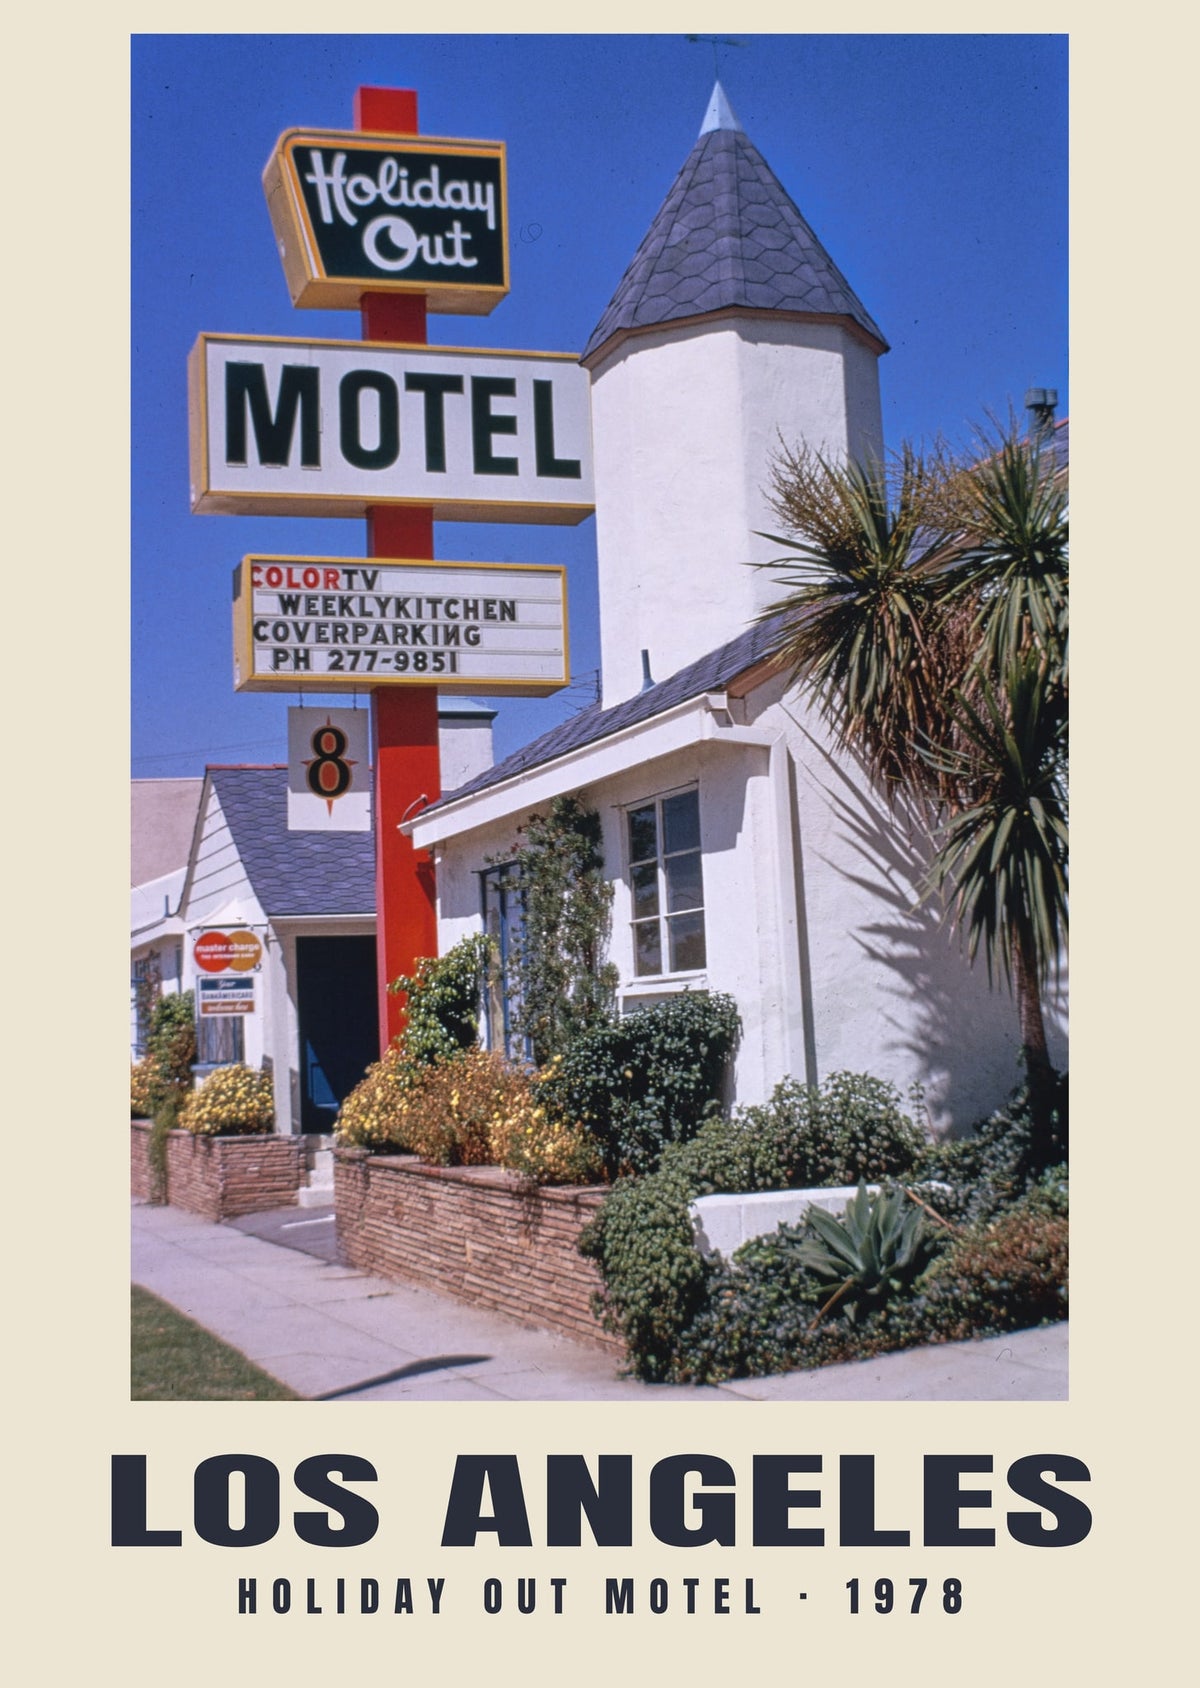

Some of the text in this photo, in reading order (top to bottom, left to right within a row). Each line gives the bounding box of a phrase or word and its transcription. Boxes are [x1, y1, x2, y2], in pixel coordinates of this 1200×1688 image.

[305, 150, 496, 230] Holiday
[363, 215, 478, 272] Out
[226, 361, 582, 479] MOTEL
[272, 648, 457, 673] PH 277-9851
[306, 725, 353, 800] 8
[229, 943, 259, 953] charge
